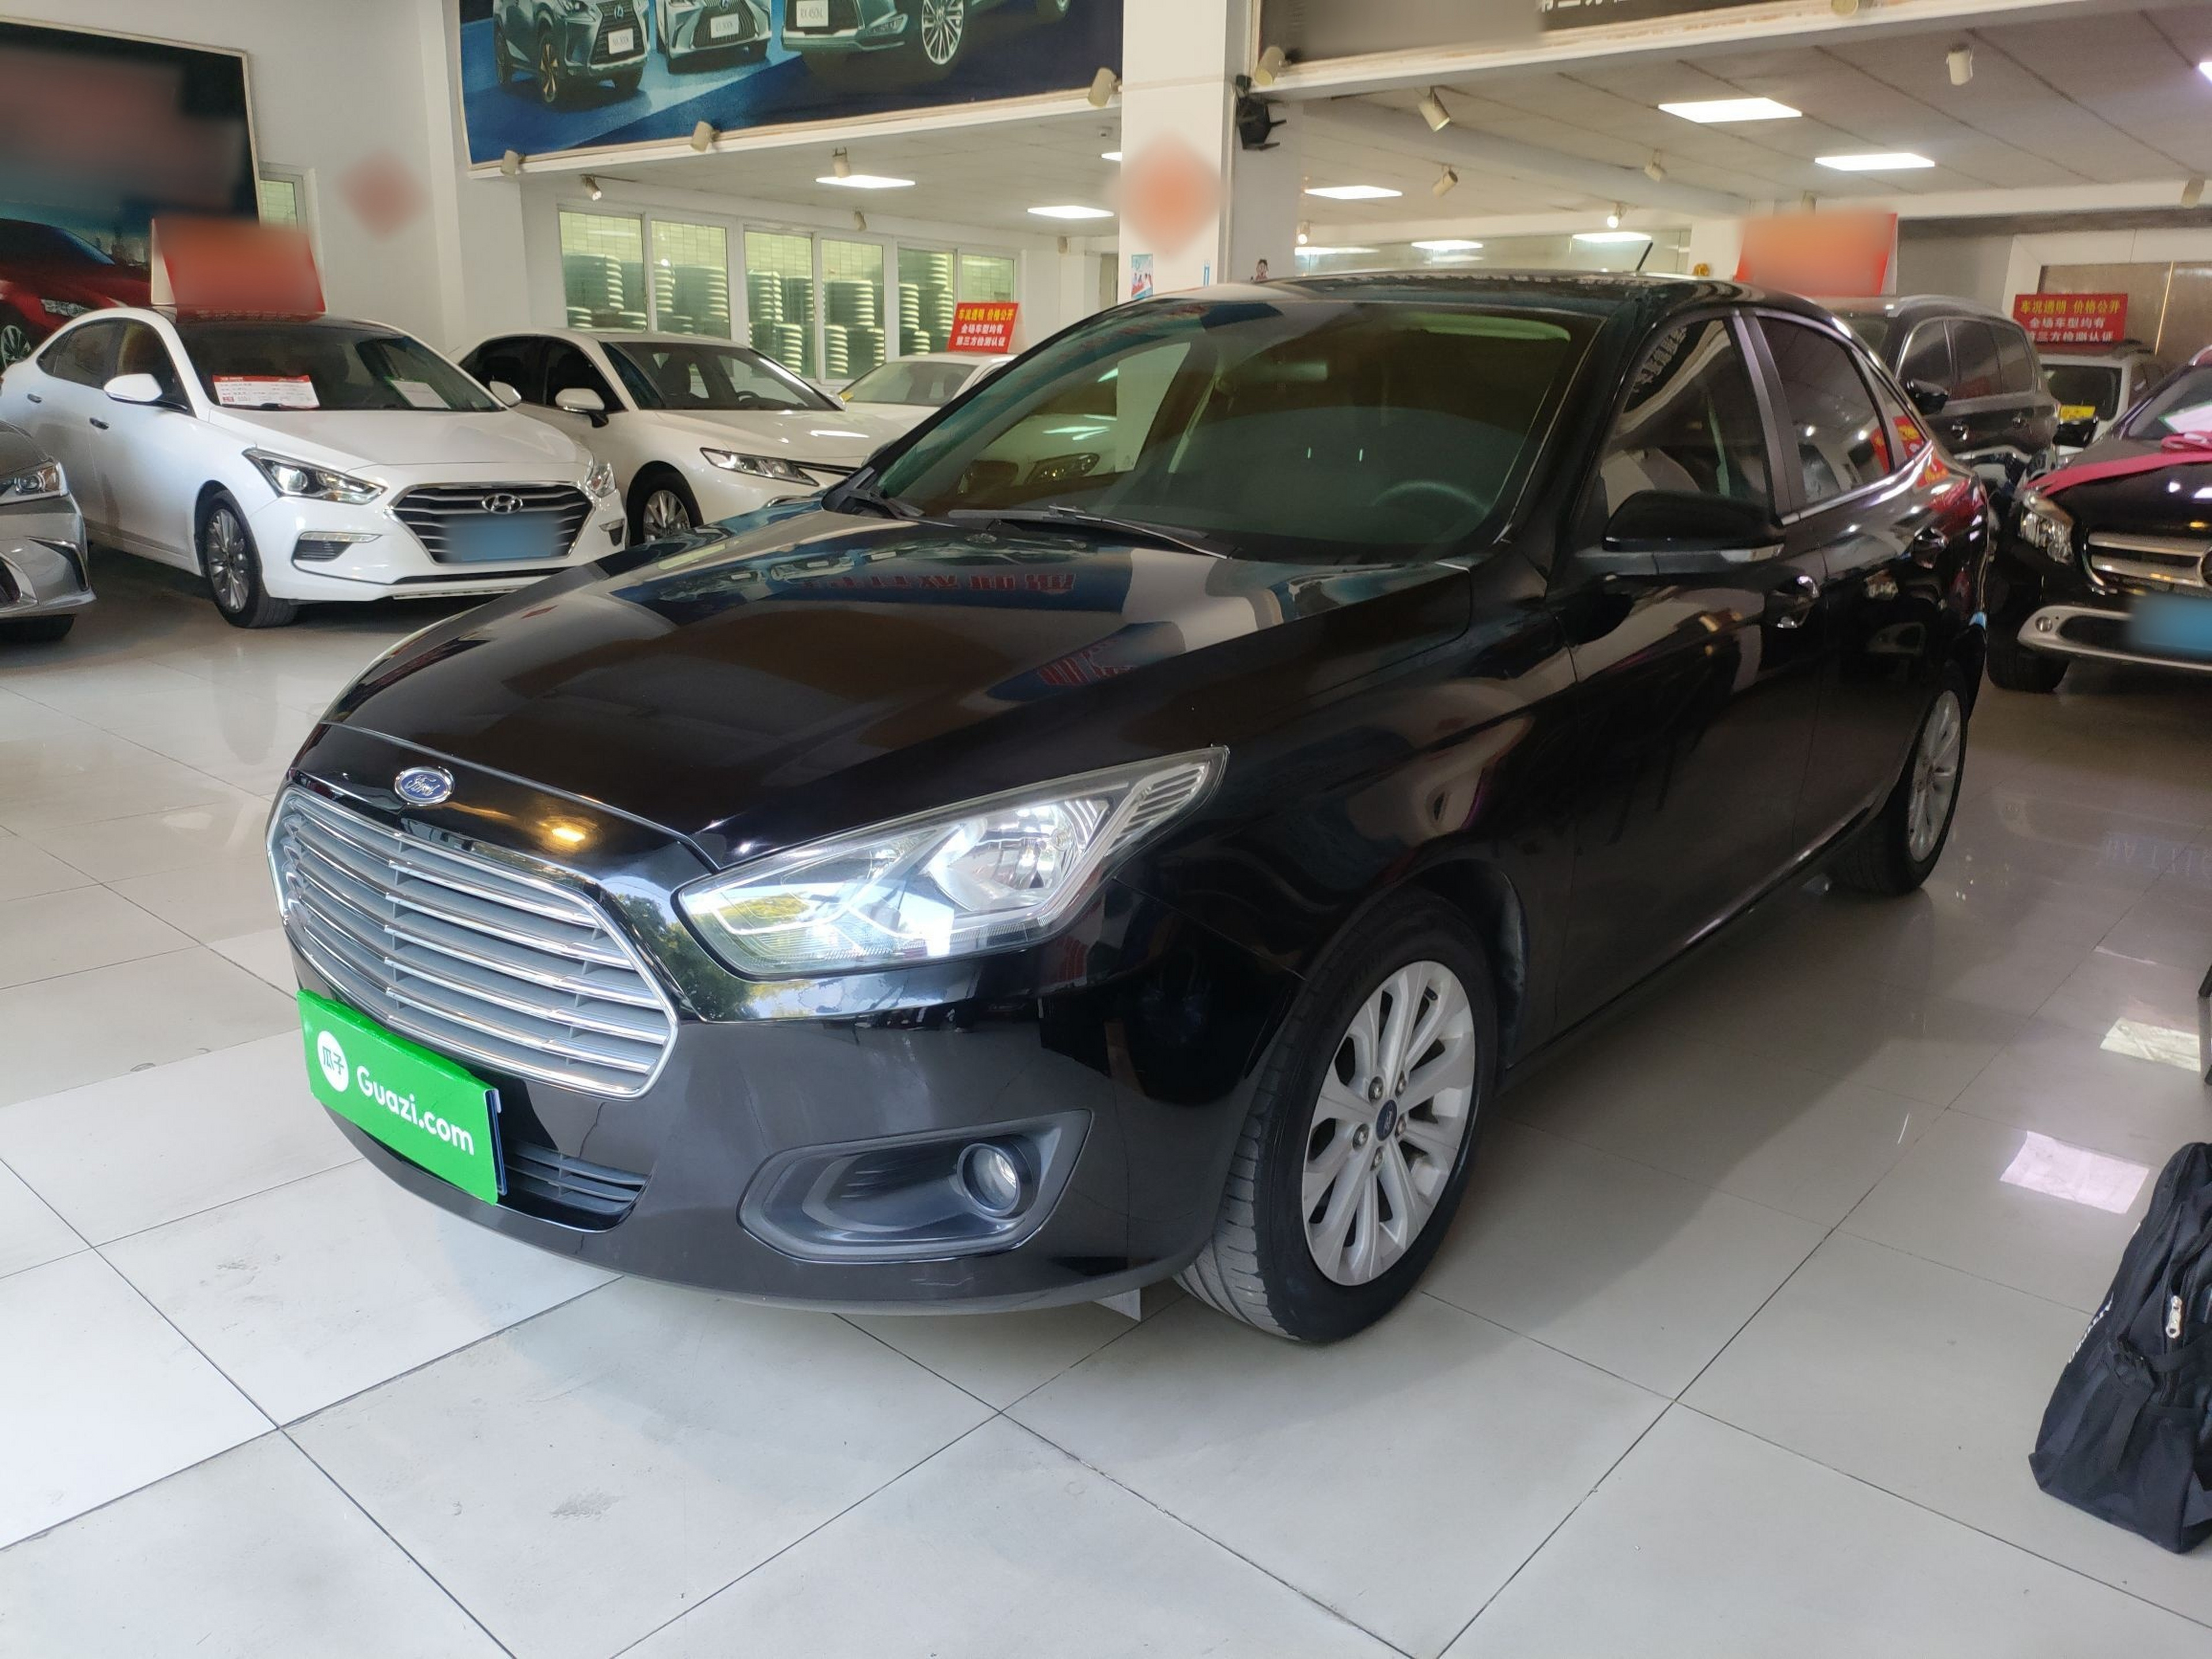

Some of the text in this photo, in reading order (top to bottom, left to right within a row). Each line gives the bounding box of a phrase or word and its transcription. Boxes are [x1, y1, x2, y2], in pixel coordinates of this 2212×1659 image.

[2020, 300, 2121, 314] 车况透明 价格公开
[958, 308, 1014, 321] 车况透明 价格公开
[961, 324, 1004, 335] 全场车型均有
[2029, 317, 2105, 329] 全场车型均有
[956, 336, 1006, 347] 第三方检测认证
[322, 1046, 345, 1075] 瓜子
[357, 1065, 474, 1156] Guazi.com
